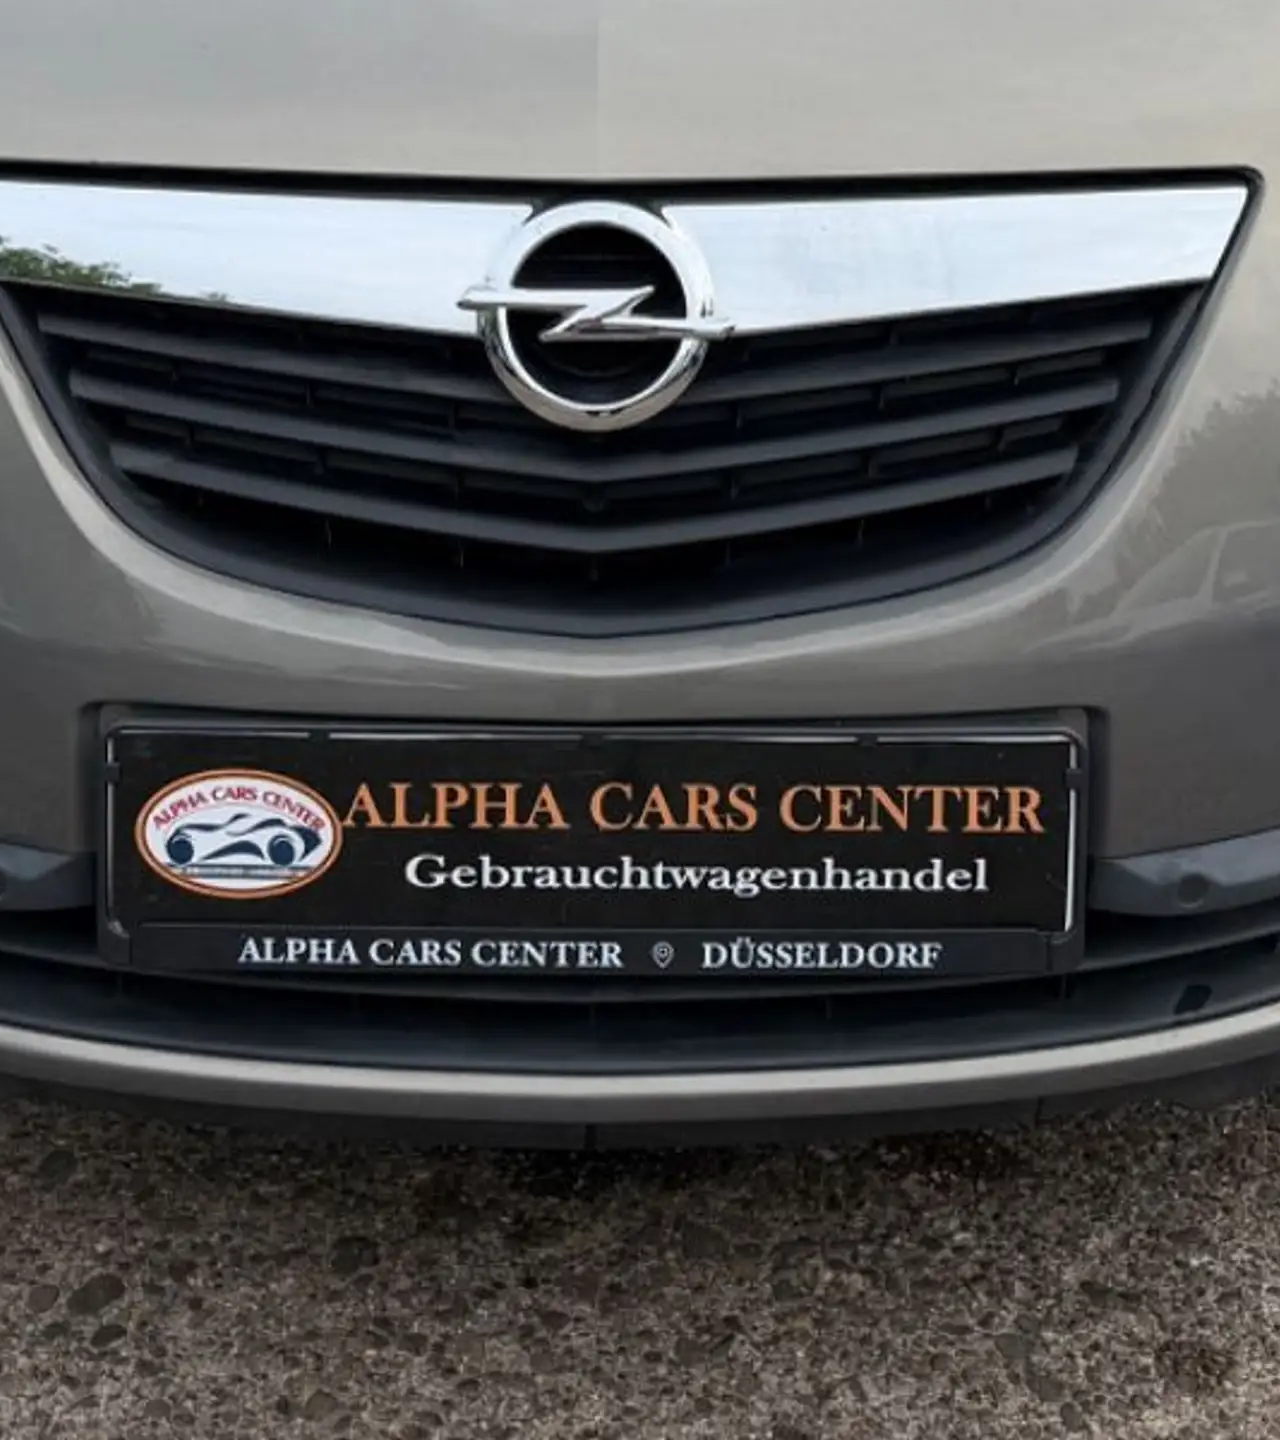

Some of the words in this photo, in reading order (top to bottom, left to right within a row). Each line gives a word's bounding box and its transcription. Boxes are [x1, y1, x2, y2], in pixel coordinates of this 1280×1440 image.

[152, 791, 208, 829] ALPHA
[211, 786, 257, 802] CARS
[263, 790, 326, 830] CENTER
[342, 782, 571, 829] ALPHA
[589, 782, 758, 831] CARS
[778, 784, 1045, 833] CENTER
[404, 853, 990, 898] Gebrauchtwagenhandel
[238, 936, 361, 964] ALPHA
[369, 937, 462, 966] CARS
[471, 940, 624, 969] CENTER
[702, 936, 943, 970] DÜSSELDORF
